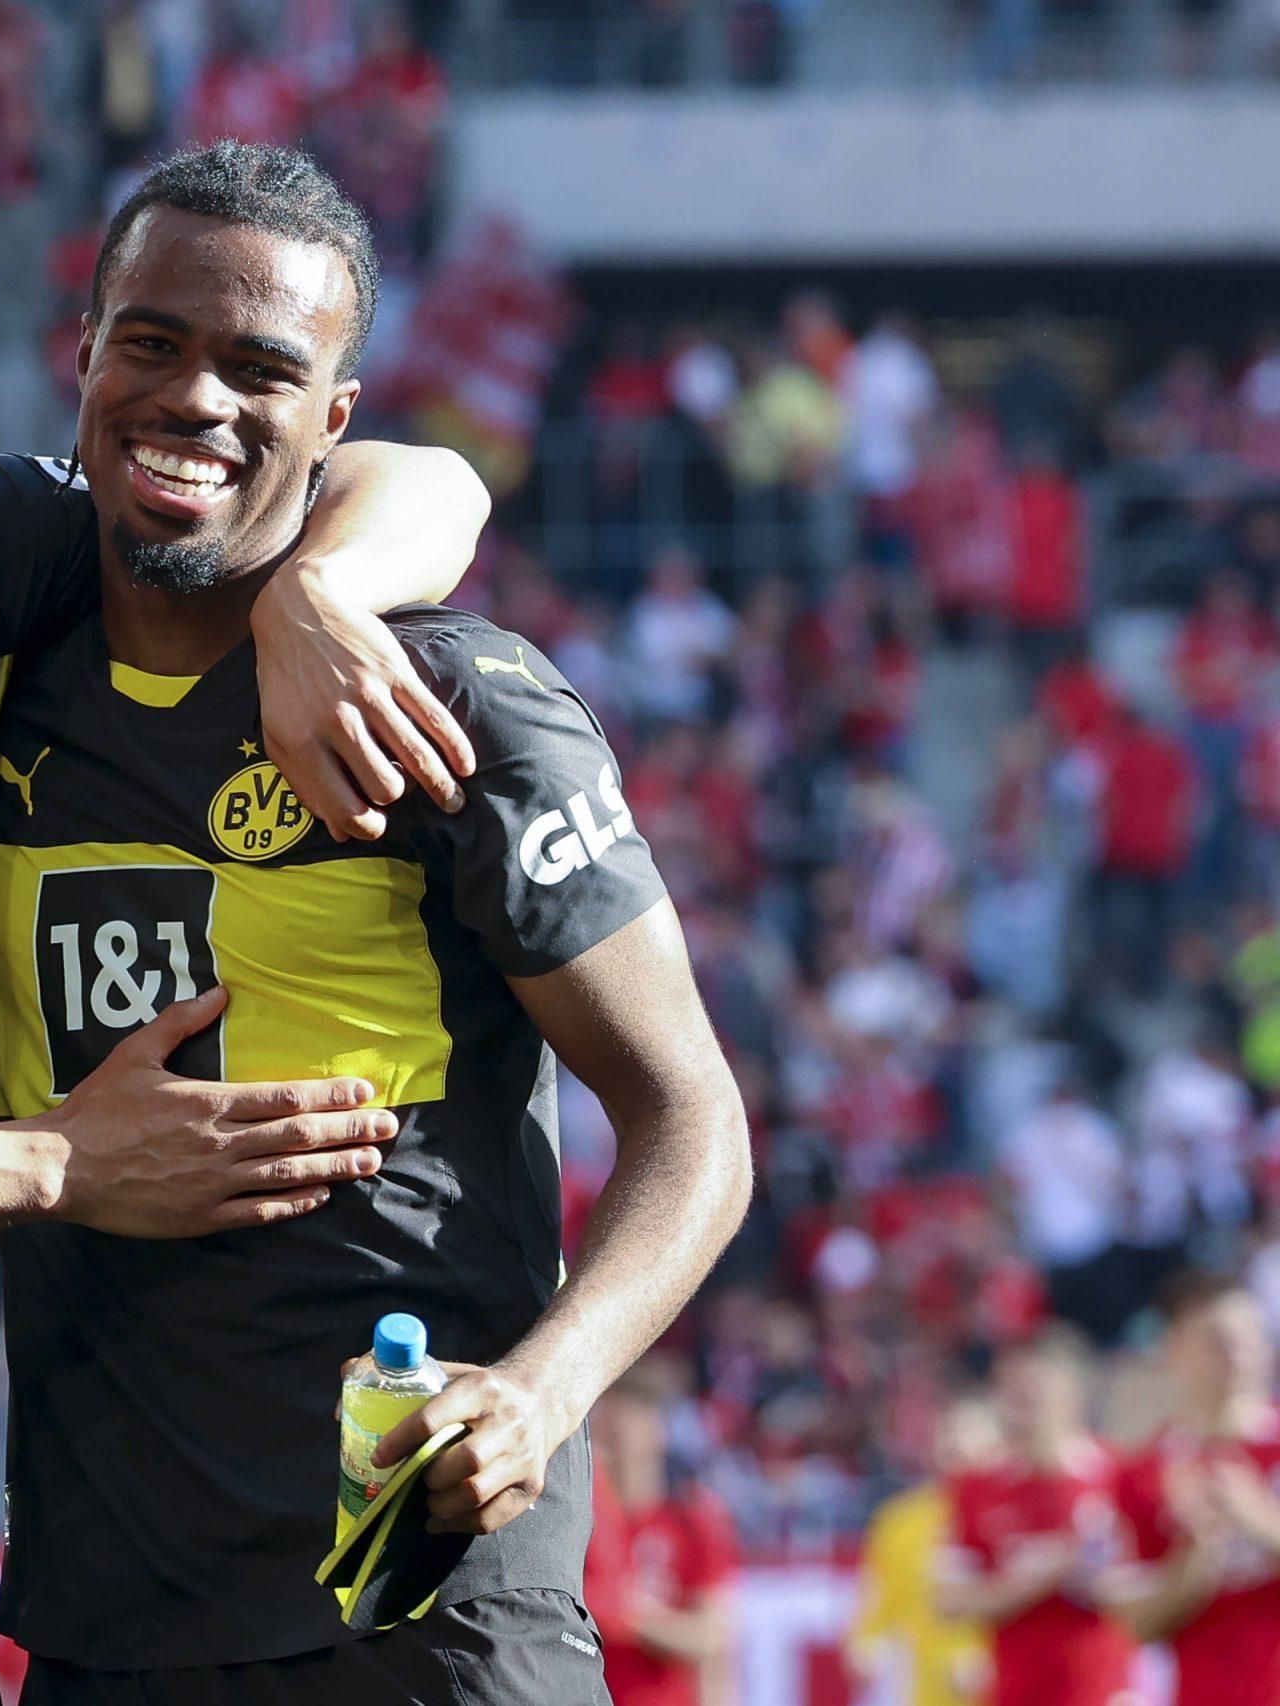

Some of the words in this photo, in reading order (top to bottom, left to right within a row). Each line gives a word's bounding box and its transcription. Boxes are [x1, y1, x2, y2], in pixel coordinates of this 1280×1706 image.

[223, 771, 303, 831] BVB
[243, 828, 273, 850] 09
[50, 919, 197, 1031] 1&1
